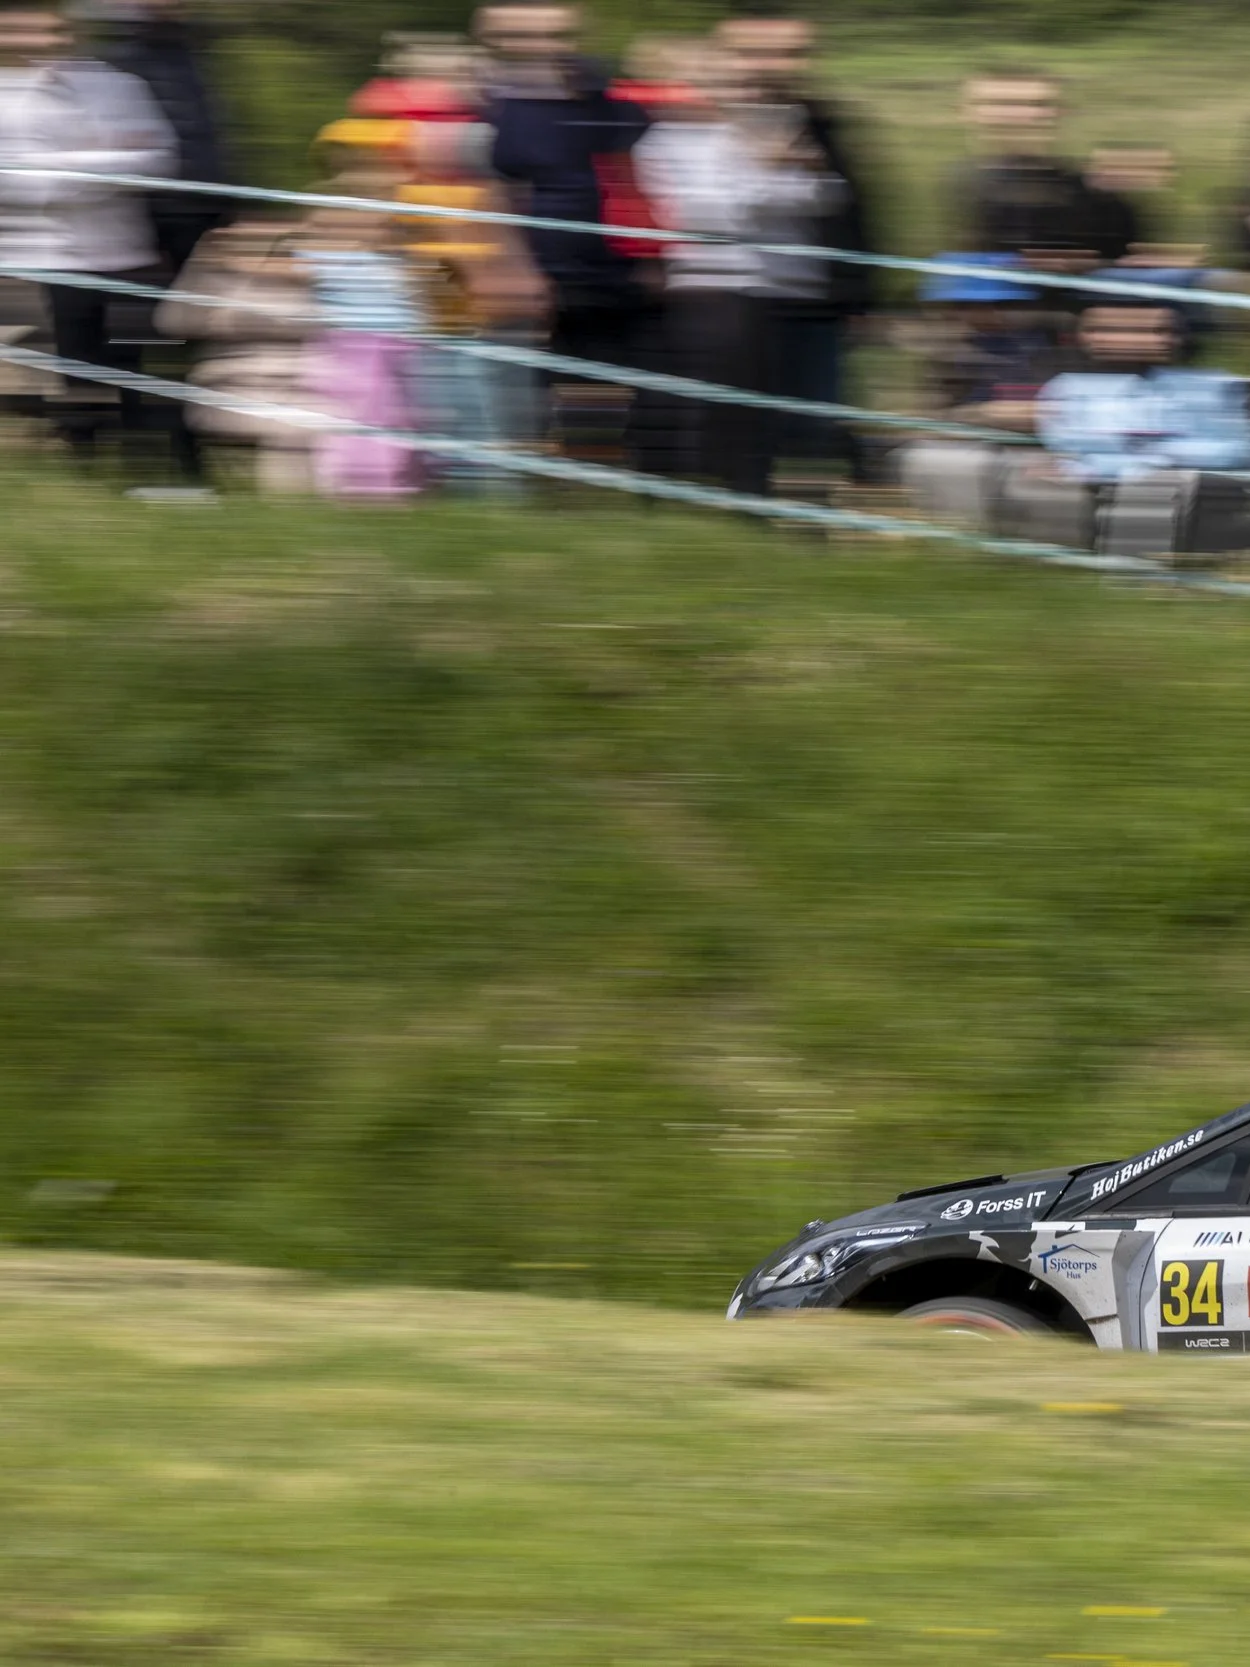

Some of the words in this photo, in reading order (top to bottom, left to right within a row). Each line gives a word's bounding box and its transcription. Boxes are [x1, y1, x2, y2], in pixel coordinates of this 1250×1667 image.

[1091, 1130, 1204, 1201] HojButiken.se
[976, 1196, 1024, 1215] Forss
[1027, 1191, 1047, 1209] IT
[1050, 1258, 1097, 1274] Sjötorps
[1066, 1271, 1081, 1280] Hus
[1162, 1261, 1222, 1326] 34
[1184, 1337, 1231, 1347] WRC2
